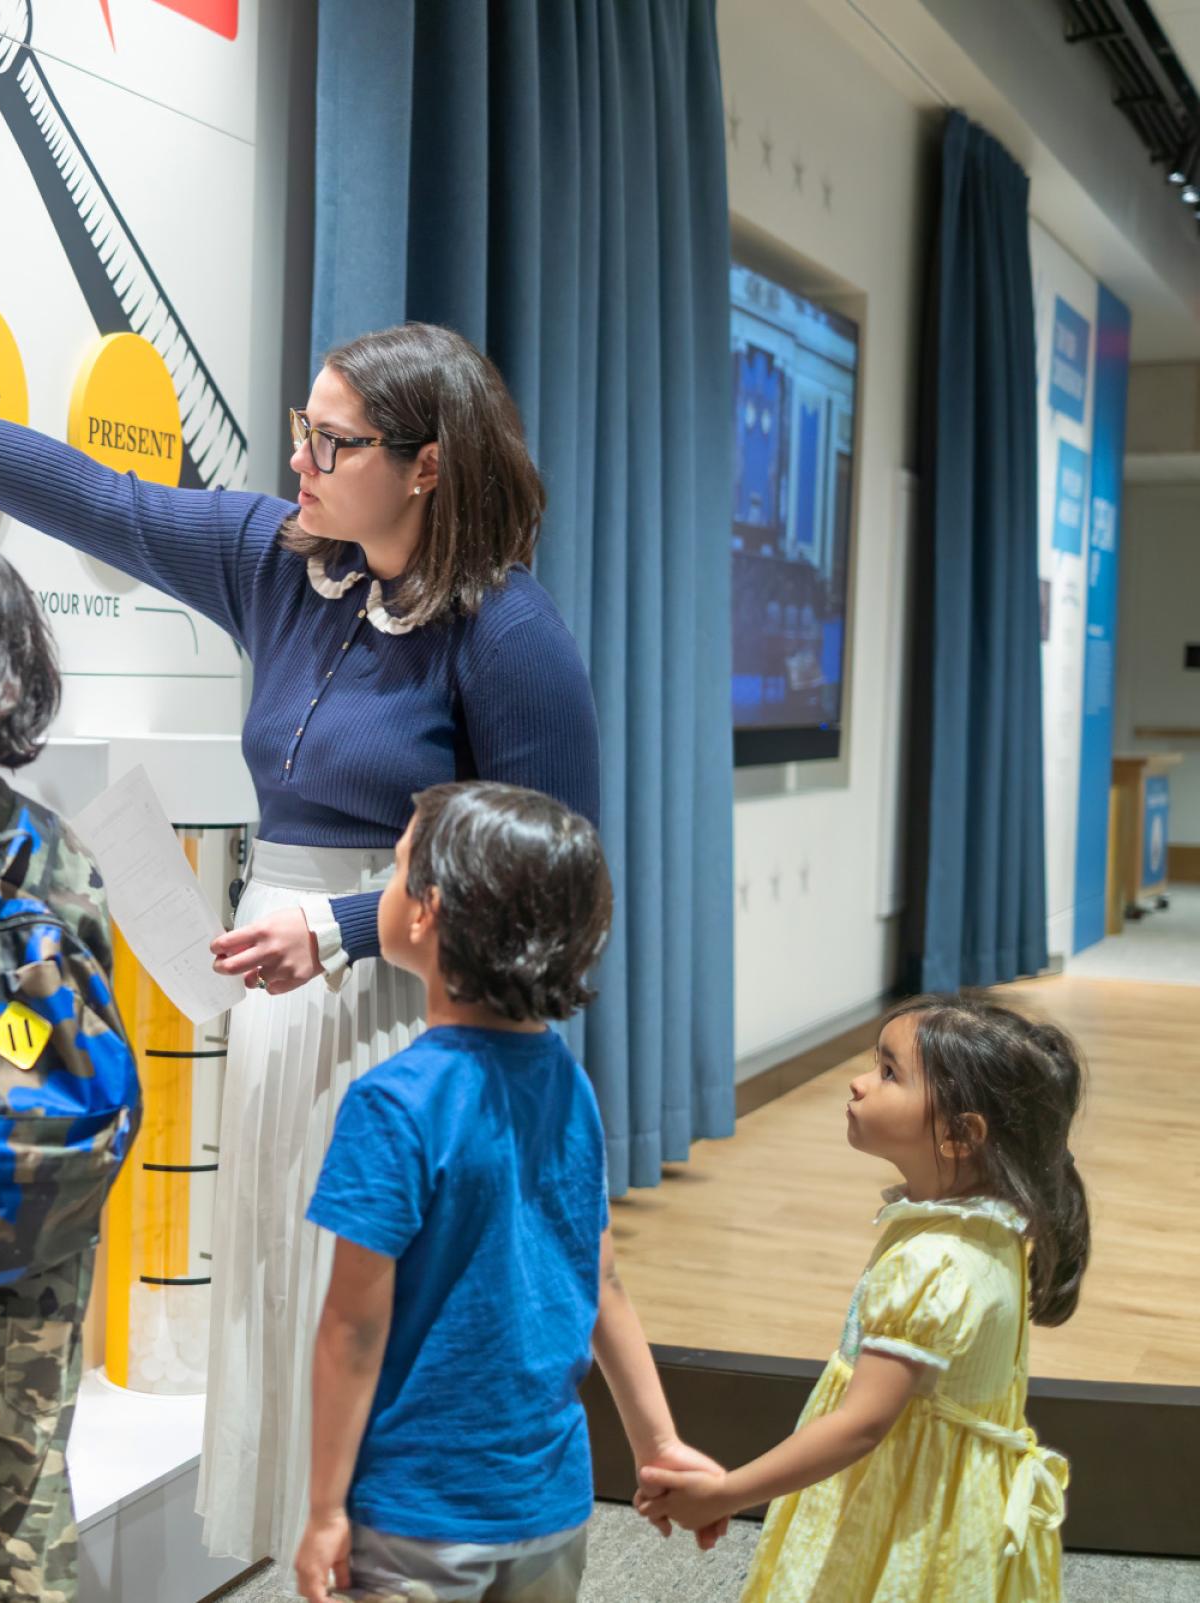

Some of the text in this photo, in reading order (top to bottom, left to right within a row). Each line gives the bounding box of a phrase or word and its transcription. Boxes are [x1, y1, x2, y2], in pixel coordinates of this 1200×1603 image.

[88, 416, 175, 459] PRESENT
[40, 591, 79, 615] YOUR
[84, 595, 120, 617] VOTE
